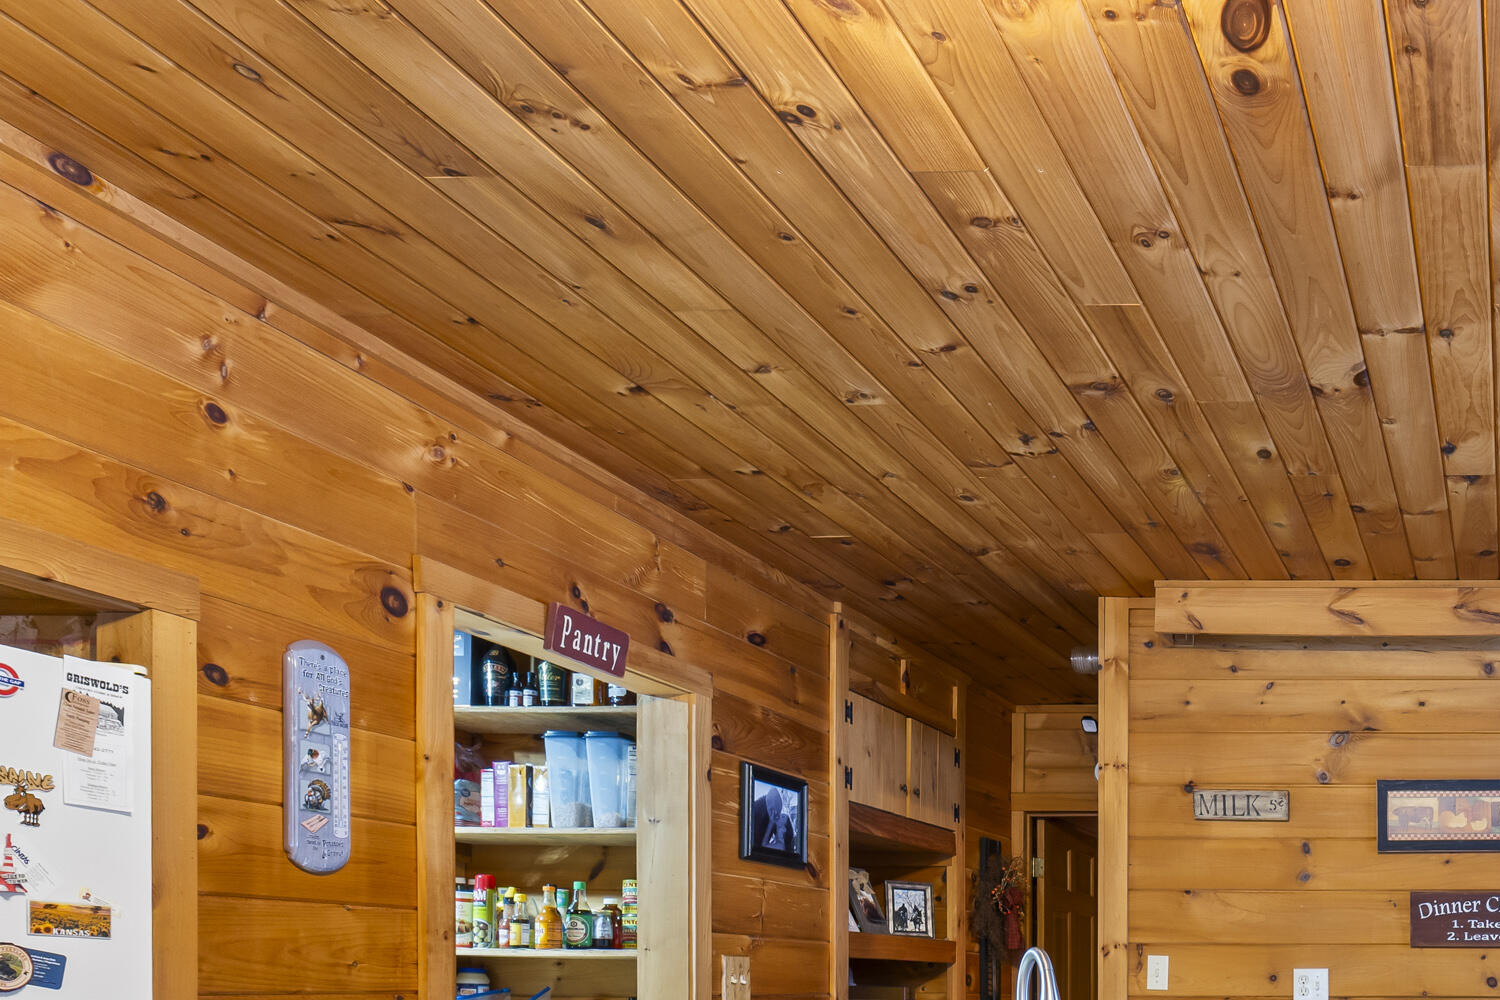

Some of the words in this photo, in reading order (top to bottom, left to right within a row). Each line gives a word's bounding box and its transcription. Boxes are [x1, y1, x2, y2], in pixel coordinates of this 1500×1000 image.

[560, 615, 621, 671] Pantry
[66, 672, 129, 695] GRISWOLD'S
[1199, 793, 1261, 817] MILK
[1418, 899, 1480, 919] Dinner
[52, 927, 90, 937] KANSAS
[1451, 919, 1464, 929] 1.
[1447, 931, 1460, 941] 2.
